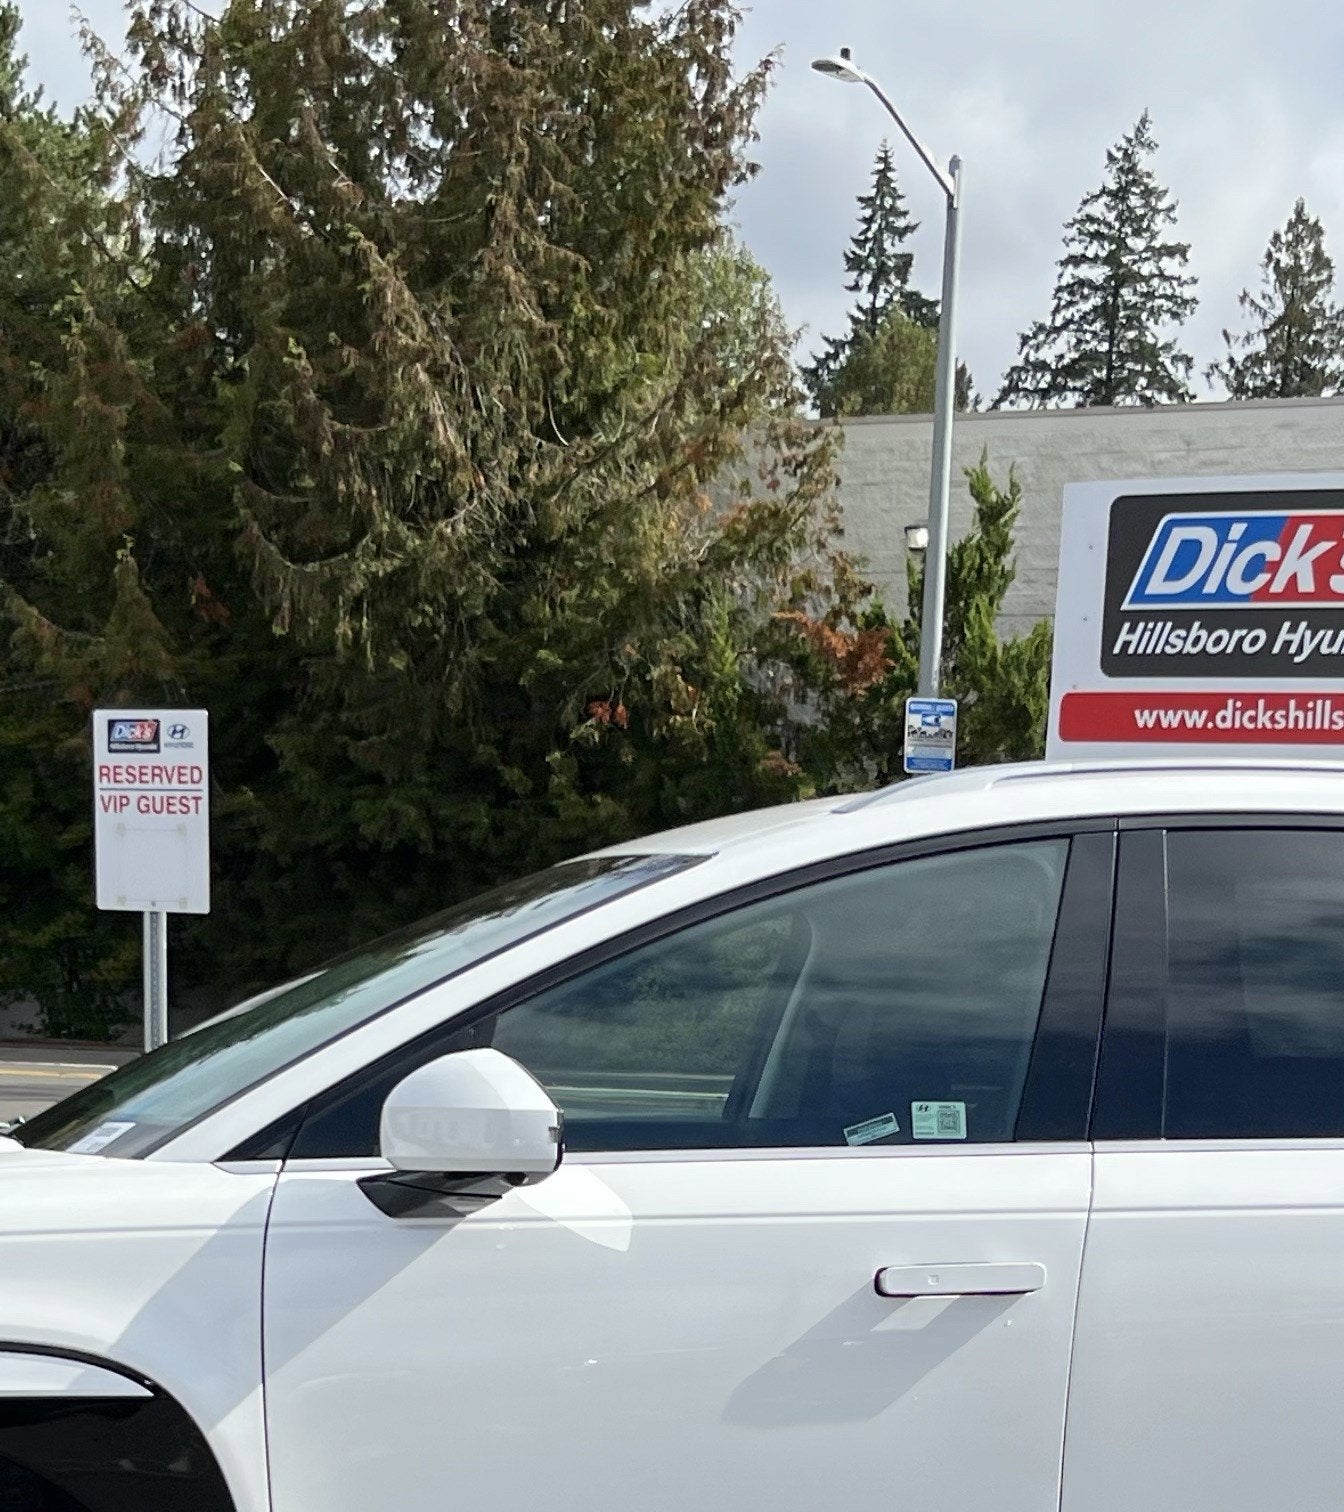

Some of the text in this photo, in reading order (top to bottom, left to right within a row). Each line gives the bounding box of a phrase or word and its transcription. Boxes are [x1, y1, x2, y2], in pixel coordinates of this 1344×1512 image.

[1112, 619, 1268, 656] Hillsboro
[99, 765, 203, 785] RESERVED
[100, 795, 203, 815] VIP GUEST
